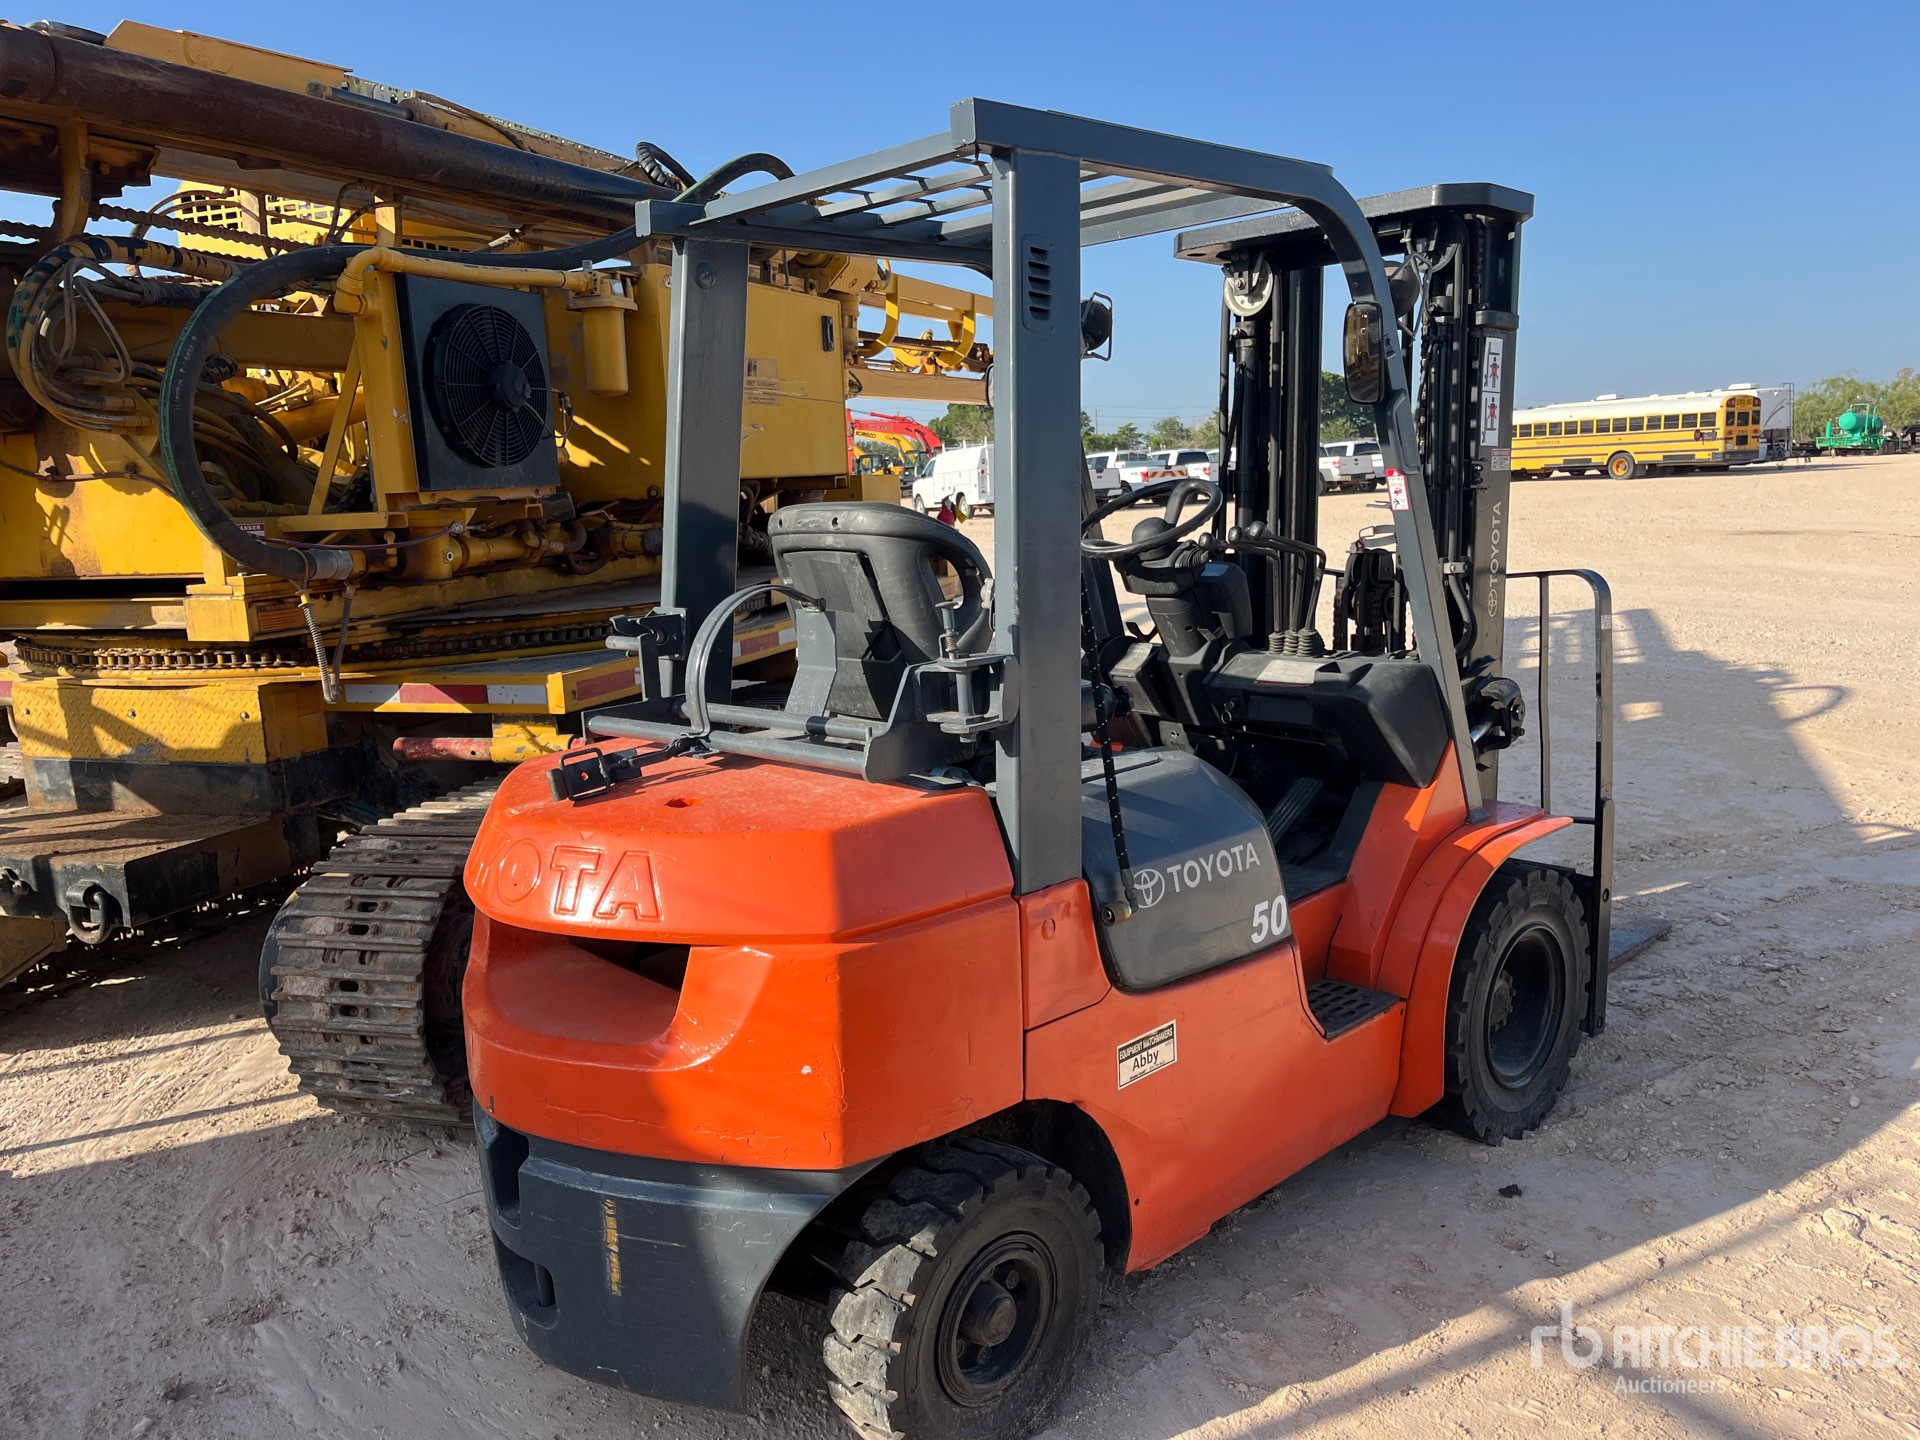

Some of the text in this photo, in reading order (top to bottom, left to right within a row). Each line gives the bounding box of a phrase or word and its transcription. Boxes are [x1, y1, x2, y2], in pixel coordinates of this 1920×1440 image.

[1489, 501, 1502, 588] TOYOTA
[1166, 842, 1261, 893] TOYOTA
[1250, 895, 1288, 944] 50
[1119, 1041, 1143, 1061] EQUIPMENT
[1132, 1049, 1160, 1072] Abby
